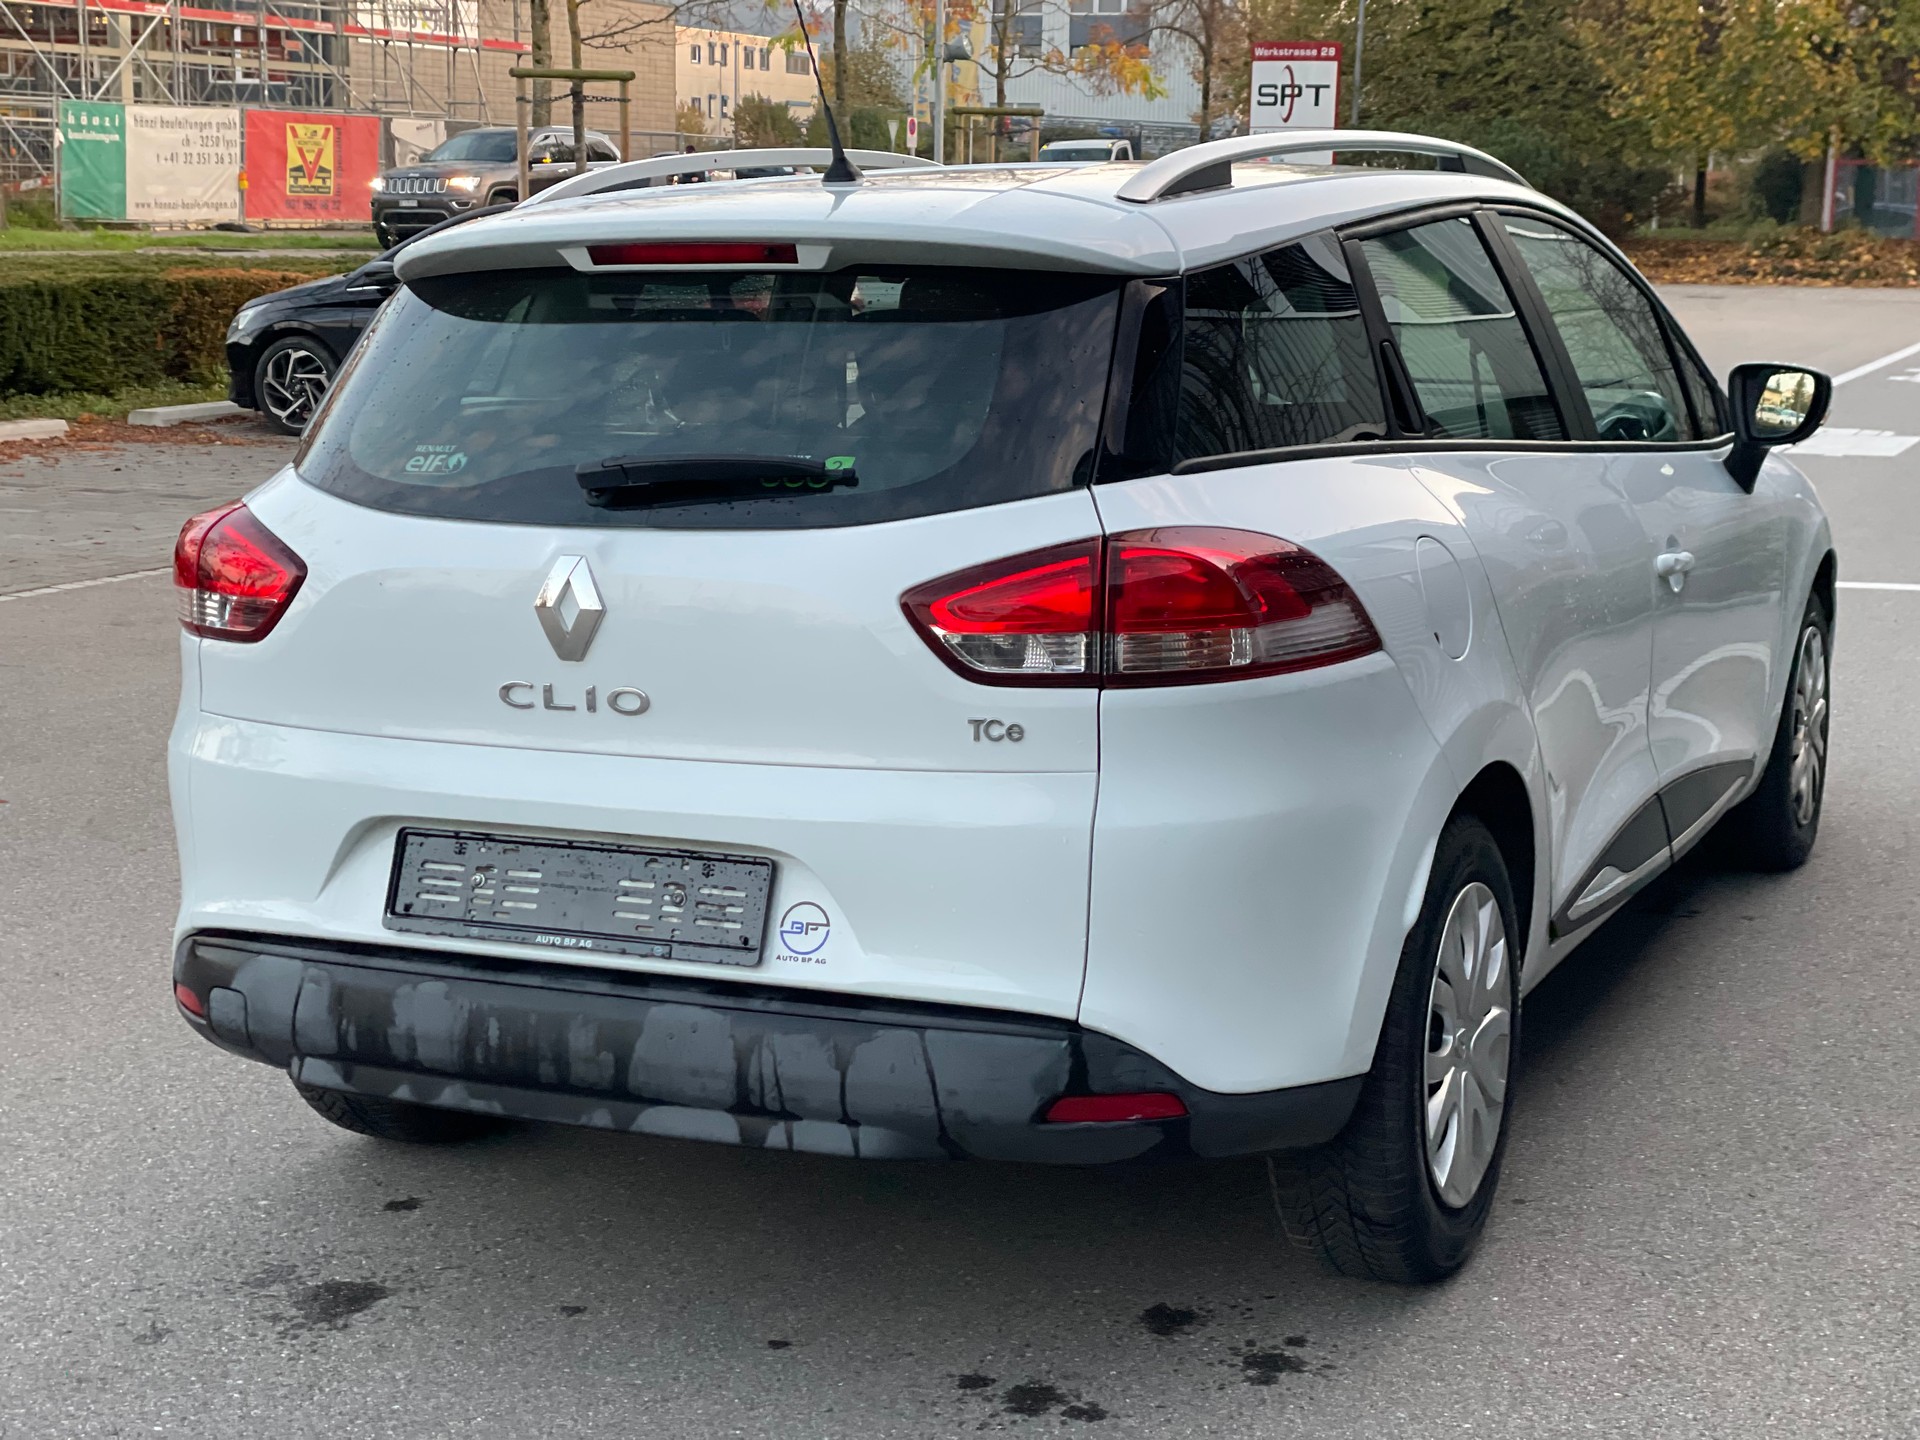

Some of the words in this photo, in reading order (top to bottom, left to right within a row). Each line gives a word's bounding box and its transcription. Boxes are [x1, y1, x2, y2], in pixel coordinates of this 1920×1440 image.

[1254, 47, 1318, 57] Werkstrasse
[1256, 83, 1331, 107] SPT
[133, 114, 158, 130] hänzi
[159, 115, 213, 131] bauleitungen
[215, 117, 238, 132] gmbh
[181, 135, 191, 148] ch
[199, 135, 220, 149] 3250
[222, 136, 238, 151] lyss
[163, 152, 179, 165] +41
[183, 152, 193, 165] 32
[196, 153, 211, 166] 351
[214, 153, 225, 165] 36
[227, 152, 238, 166] 31
[415, 444, 457, 453] RENAULT
[405, 454, 447, 472] elf
[499, 680, 651, 716] CLIO
[967, 718, 1025, 743] TCe
[535, 935, 562, 946] AUTO
[563, 936, 577, 947] BP
[578, 938, 593, 949] AG
[775, 953, 800, 963] AUTO
[801, 956, 813, 964] BP
[814, 957, 827, 965] AG
